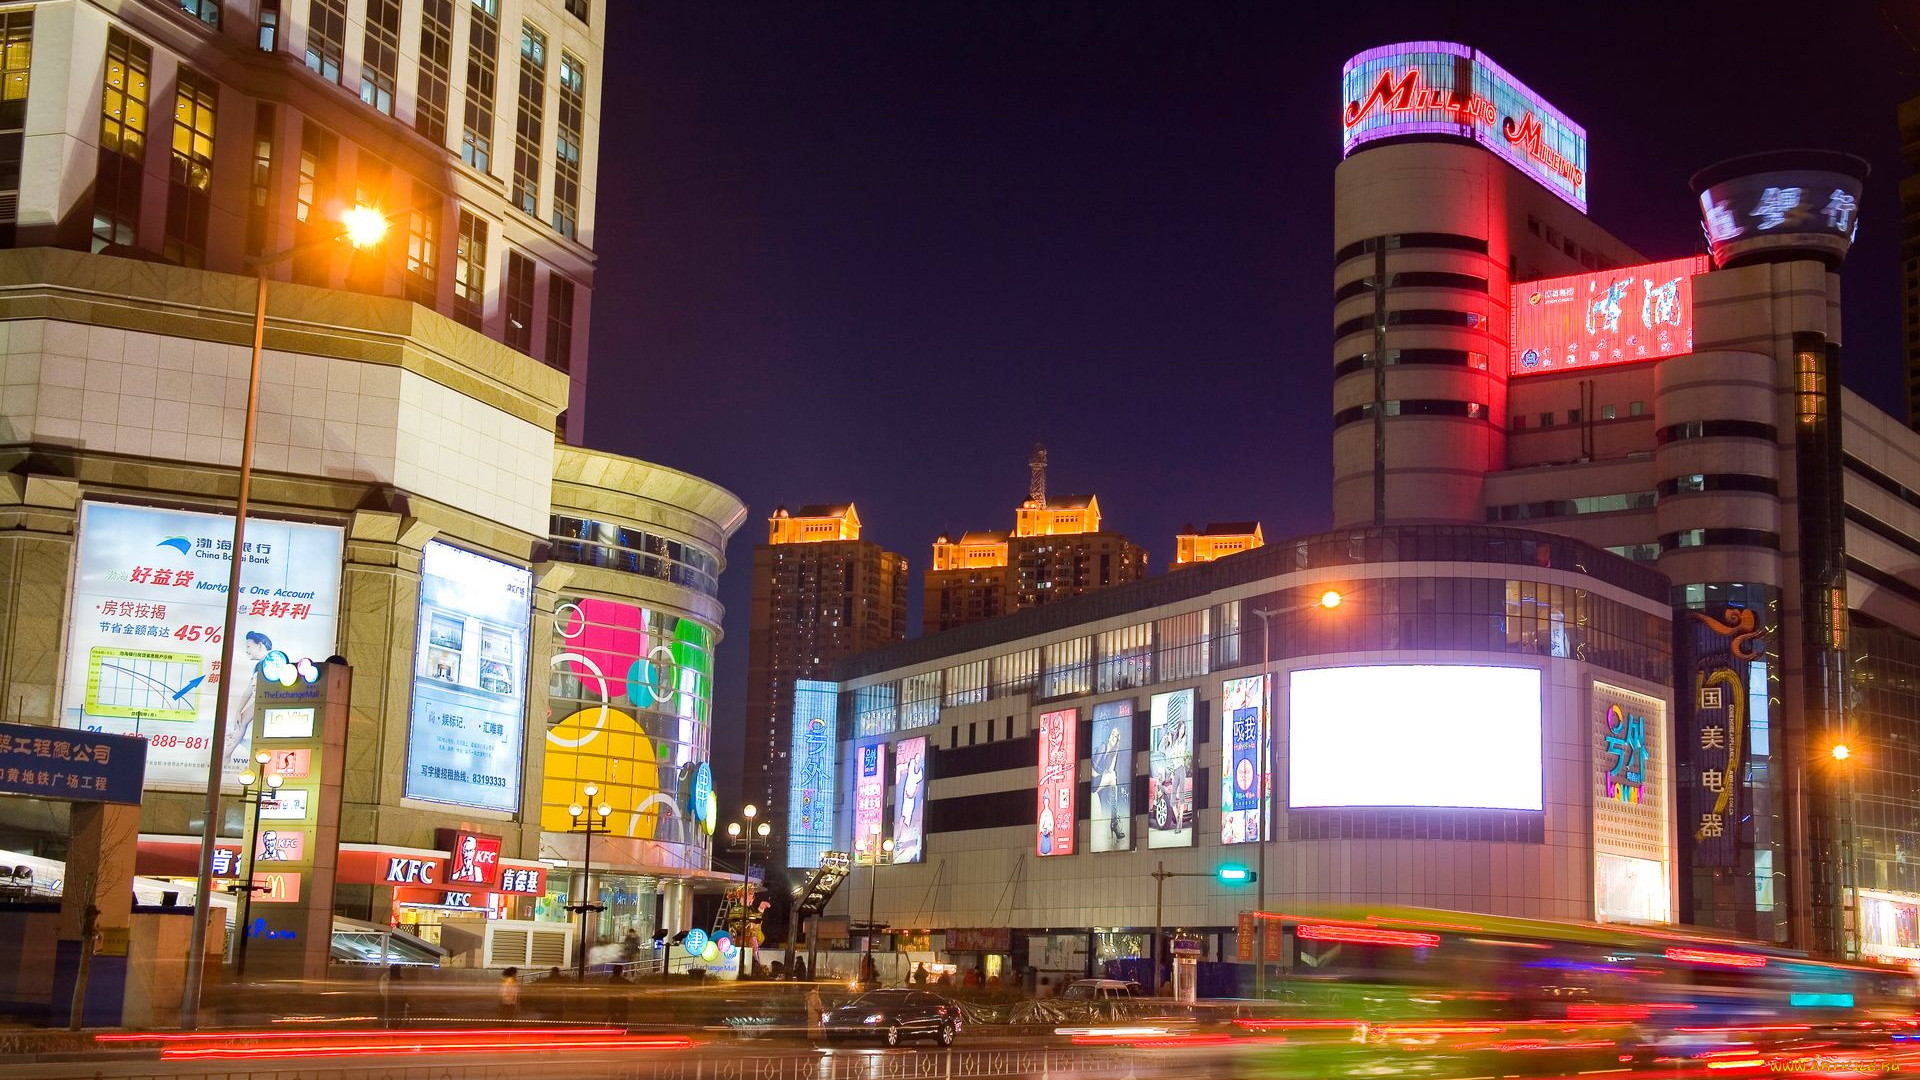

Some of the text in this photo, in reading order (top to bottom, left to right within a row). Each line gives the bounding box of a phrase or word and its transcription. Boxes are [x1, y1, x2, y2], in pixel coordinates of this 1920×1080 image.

[195, 549, 220, 561] China
[249, 554, 270, 565] Bank
[250, 586, 270, 597] One
[274, 588, 315, 600] Account
[174, 624, 222, 644] 45%
[1701, 686, 1725, 838] 国美电器
[472, 773, 506, 788] 83193333
[277, 838, 298, 848] KFC
[475, 849, 497, 865] KFC
[386, 857, 437, 884] KFC
[502, 867, 539, 893] 肯德基
[444, 891, 472, 907] KFC
